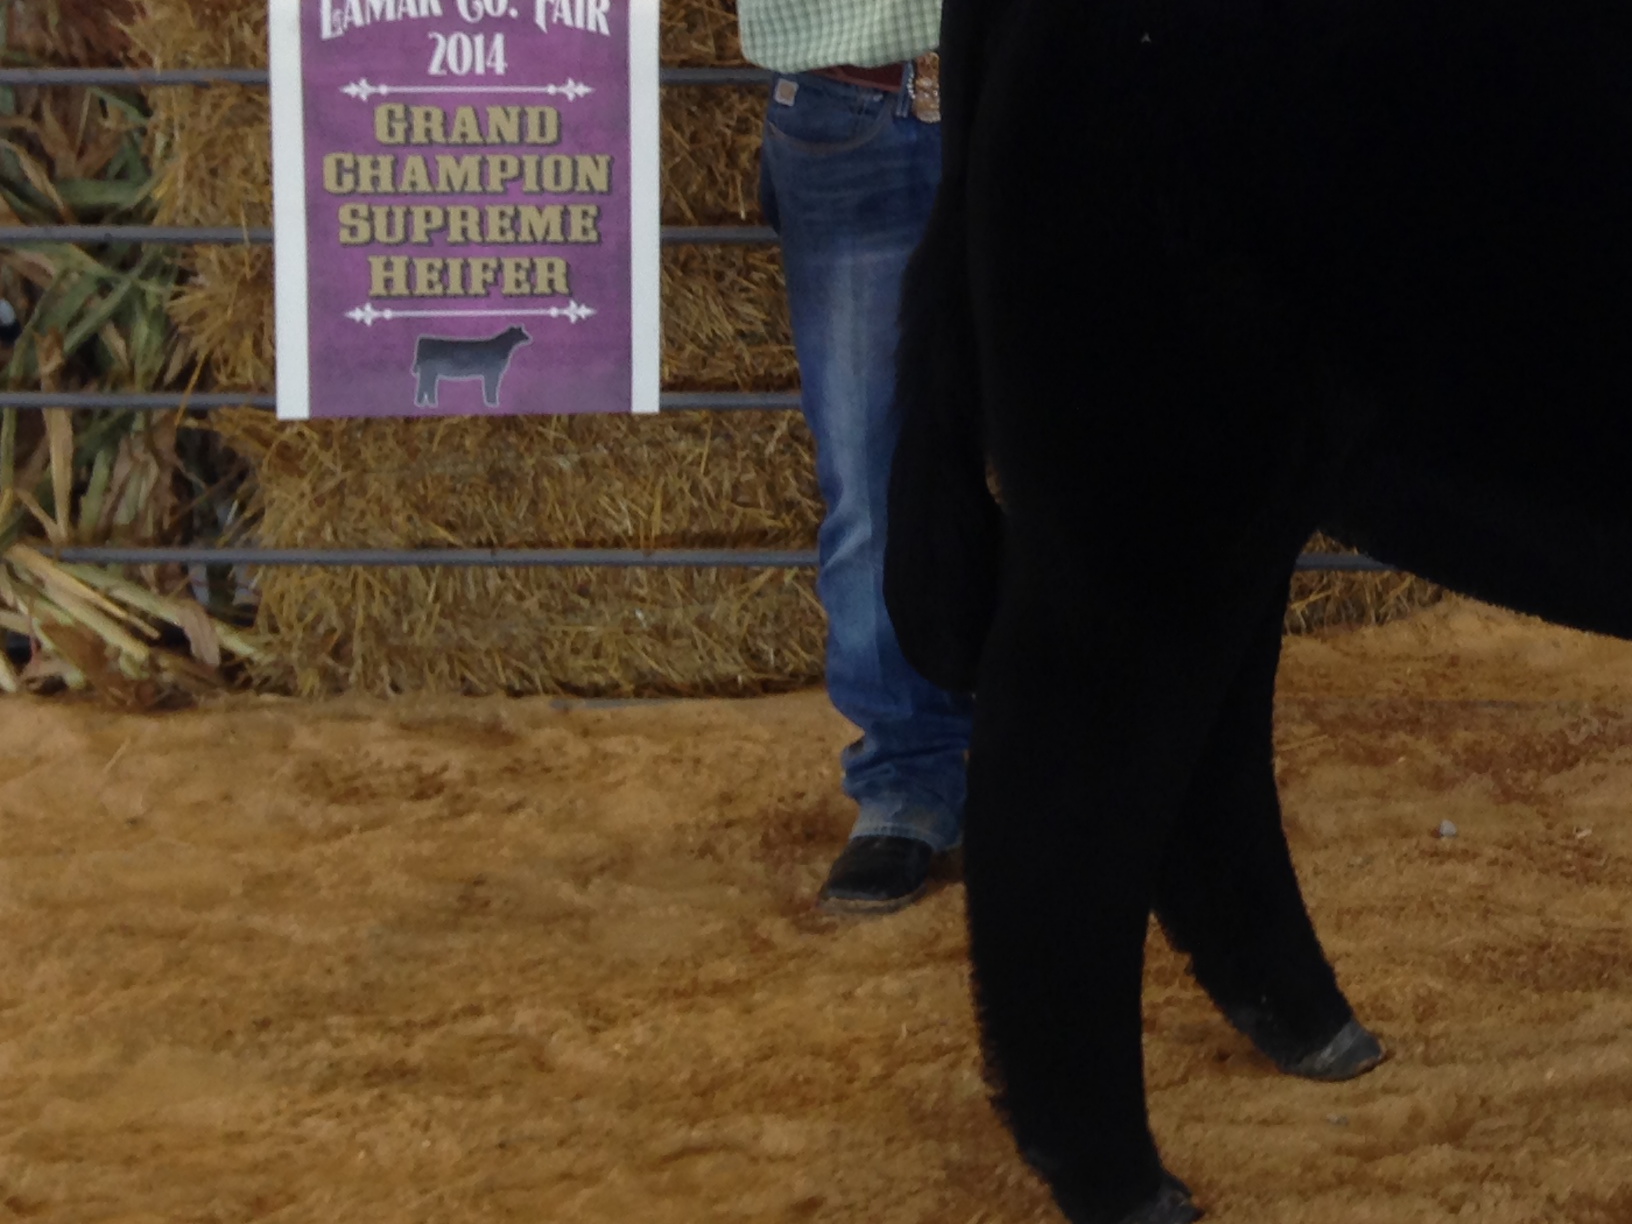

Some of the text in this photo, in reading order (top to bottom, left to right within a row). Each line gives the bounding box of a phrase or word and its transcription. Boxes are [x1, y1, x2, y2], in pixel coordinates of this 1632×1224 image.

[429, 32, 508, 75] 2014
[374, 103, 561, 145] GRAND
[323, 152, 613, 195] CHAMPION
[338, 203, 601, 246] SUPREME
[368, 255, 571, 298] HEIFER
